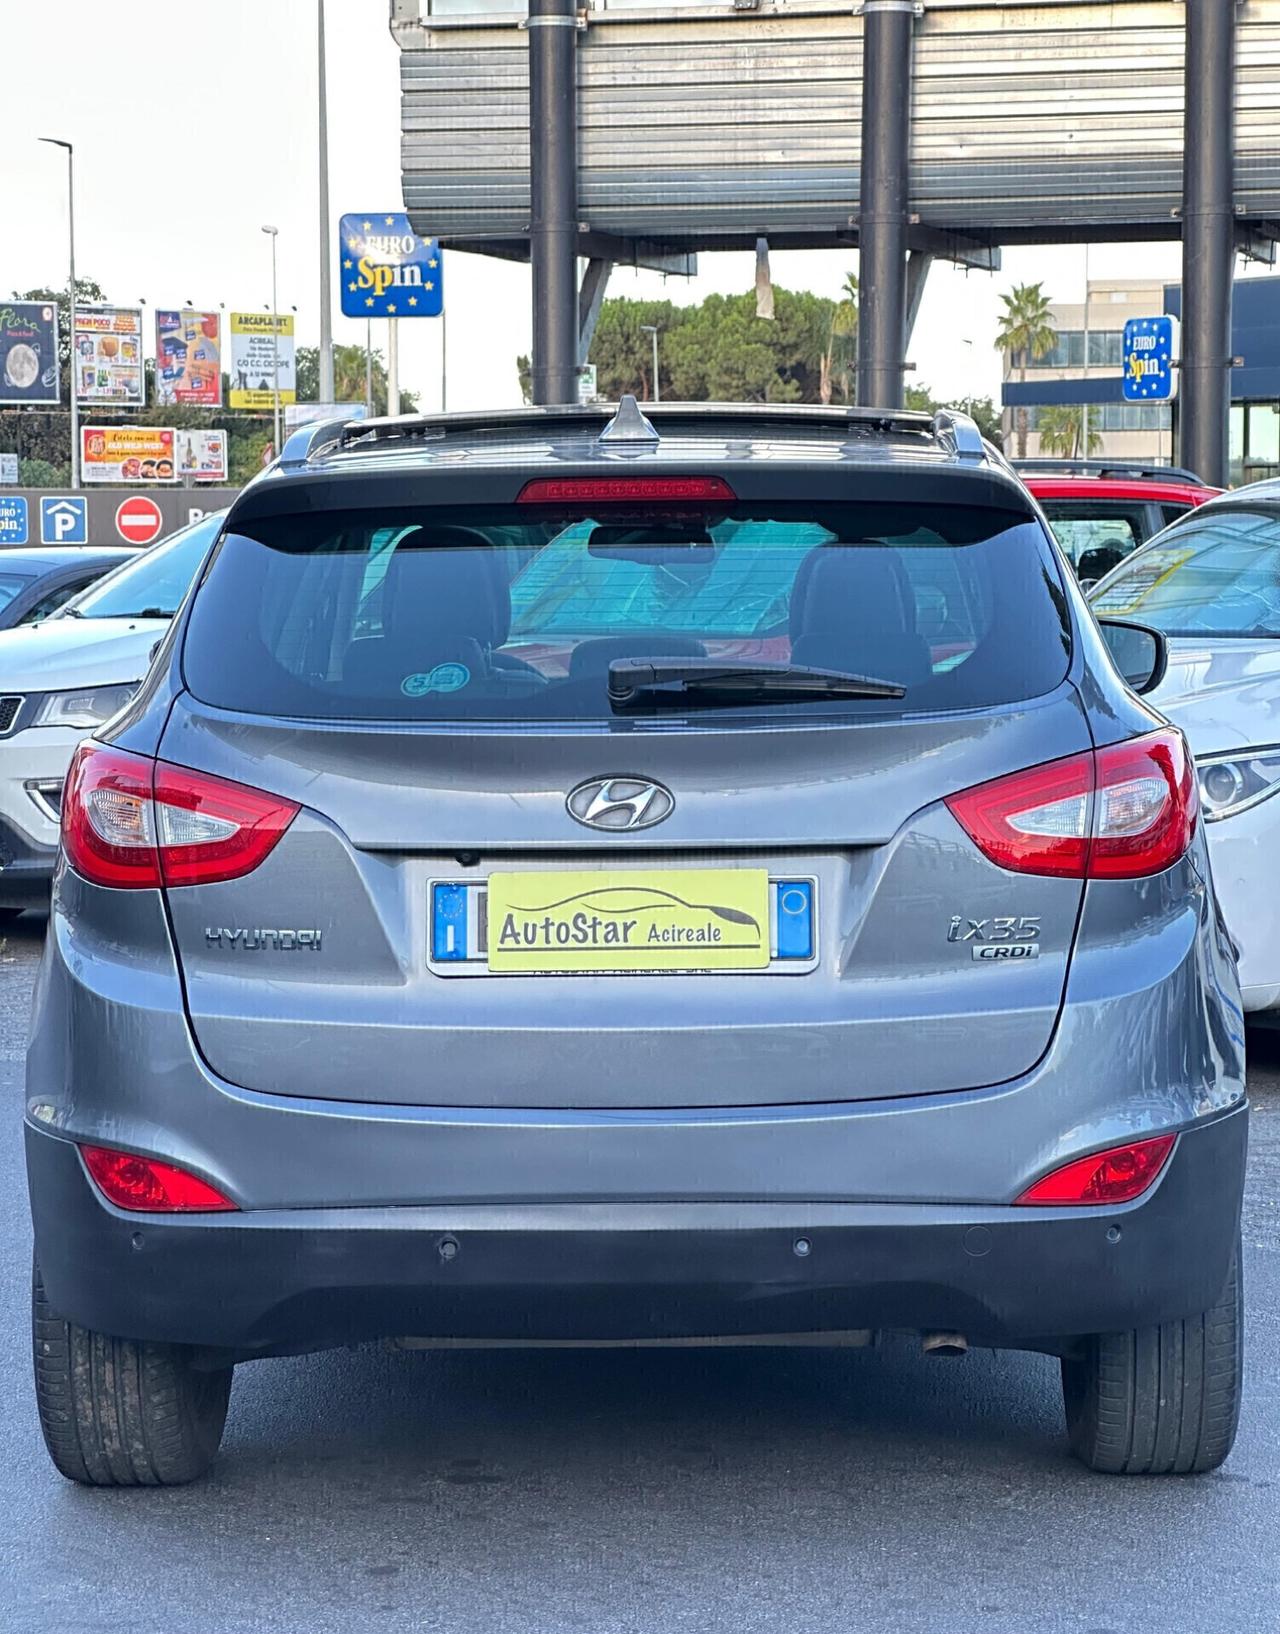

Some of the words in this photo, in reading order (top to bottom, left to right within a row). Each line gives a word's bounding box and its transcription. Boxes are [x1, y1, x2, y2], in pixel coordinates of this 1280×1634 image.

[367, 236, 415, 254] EURO
[358, 256, 423, 296] Spin
[1133, 336, 1156, 351] EURO
[1129, 352, 1159, 382] Spin
[55, 513, 75, 540] P
[205, 927, 322, 951] HYUNDAI
[500, 913, 638, 945] AutoStar
[648, 922, 722, 943] Acireale
[947, 915, 1042, 942] ix35
[979, 946, 1033, 959] CRDi
